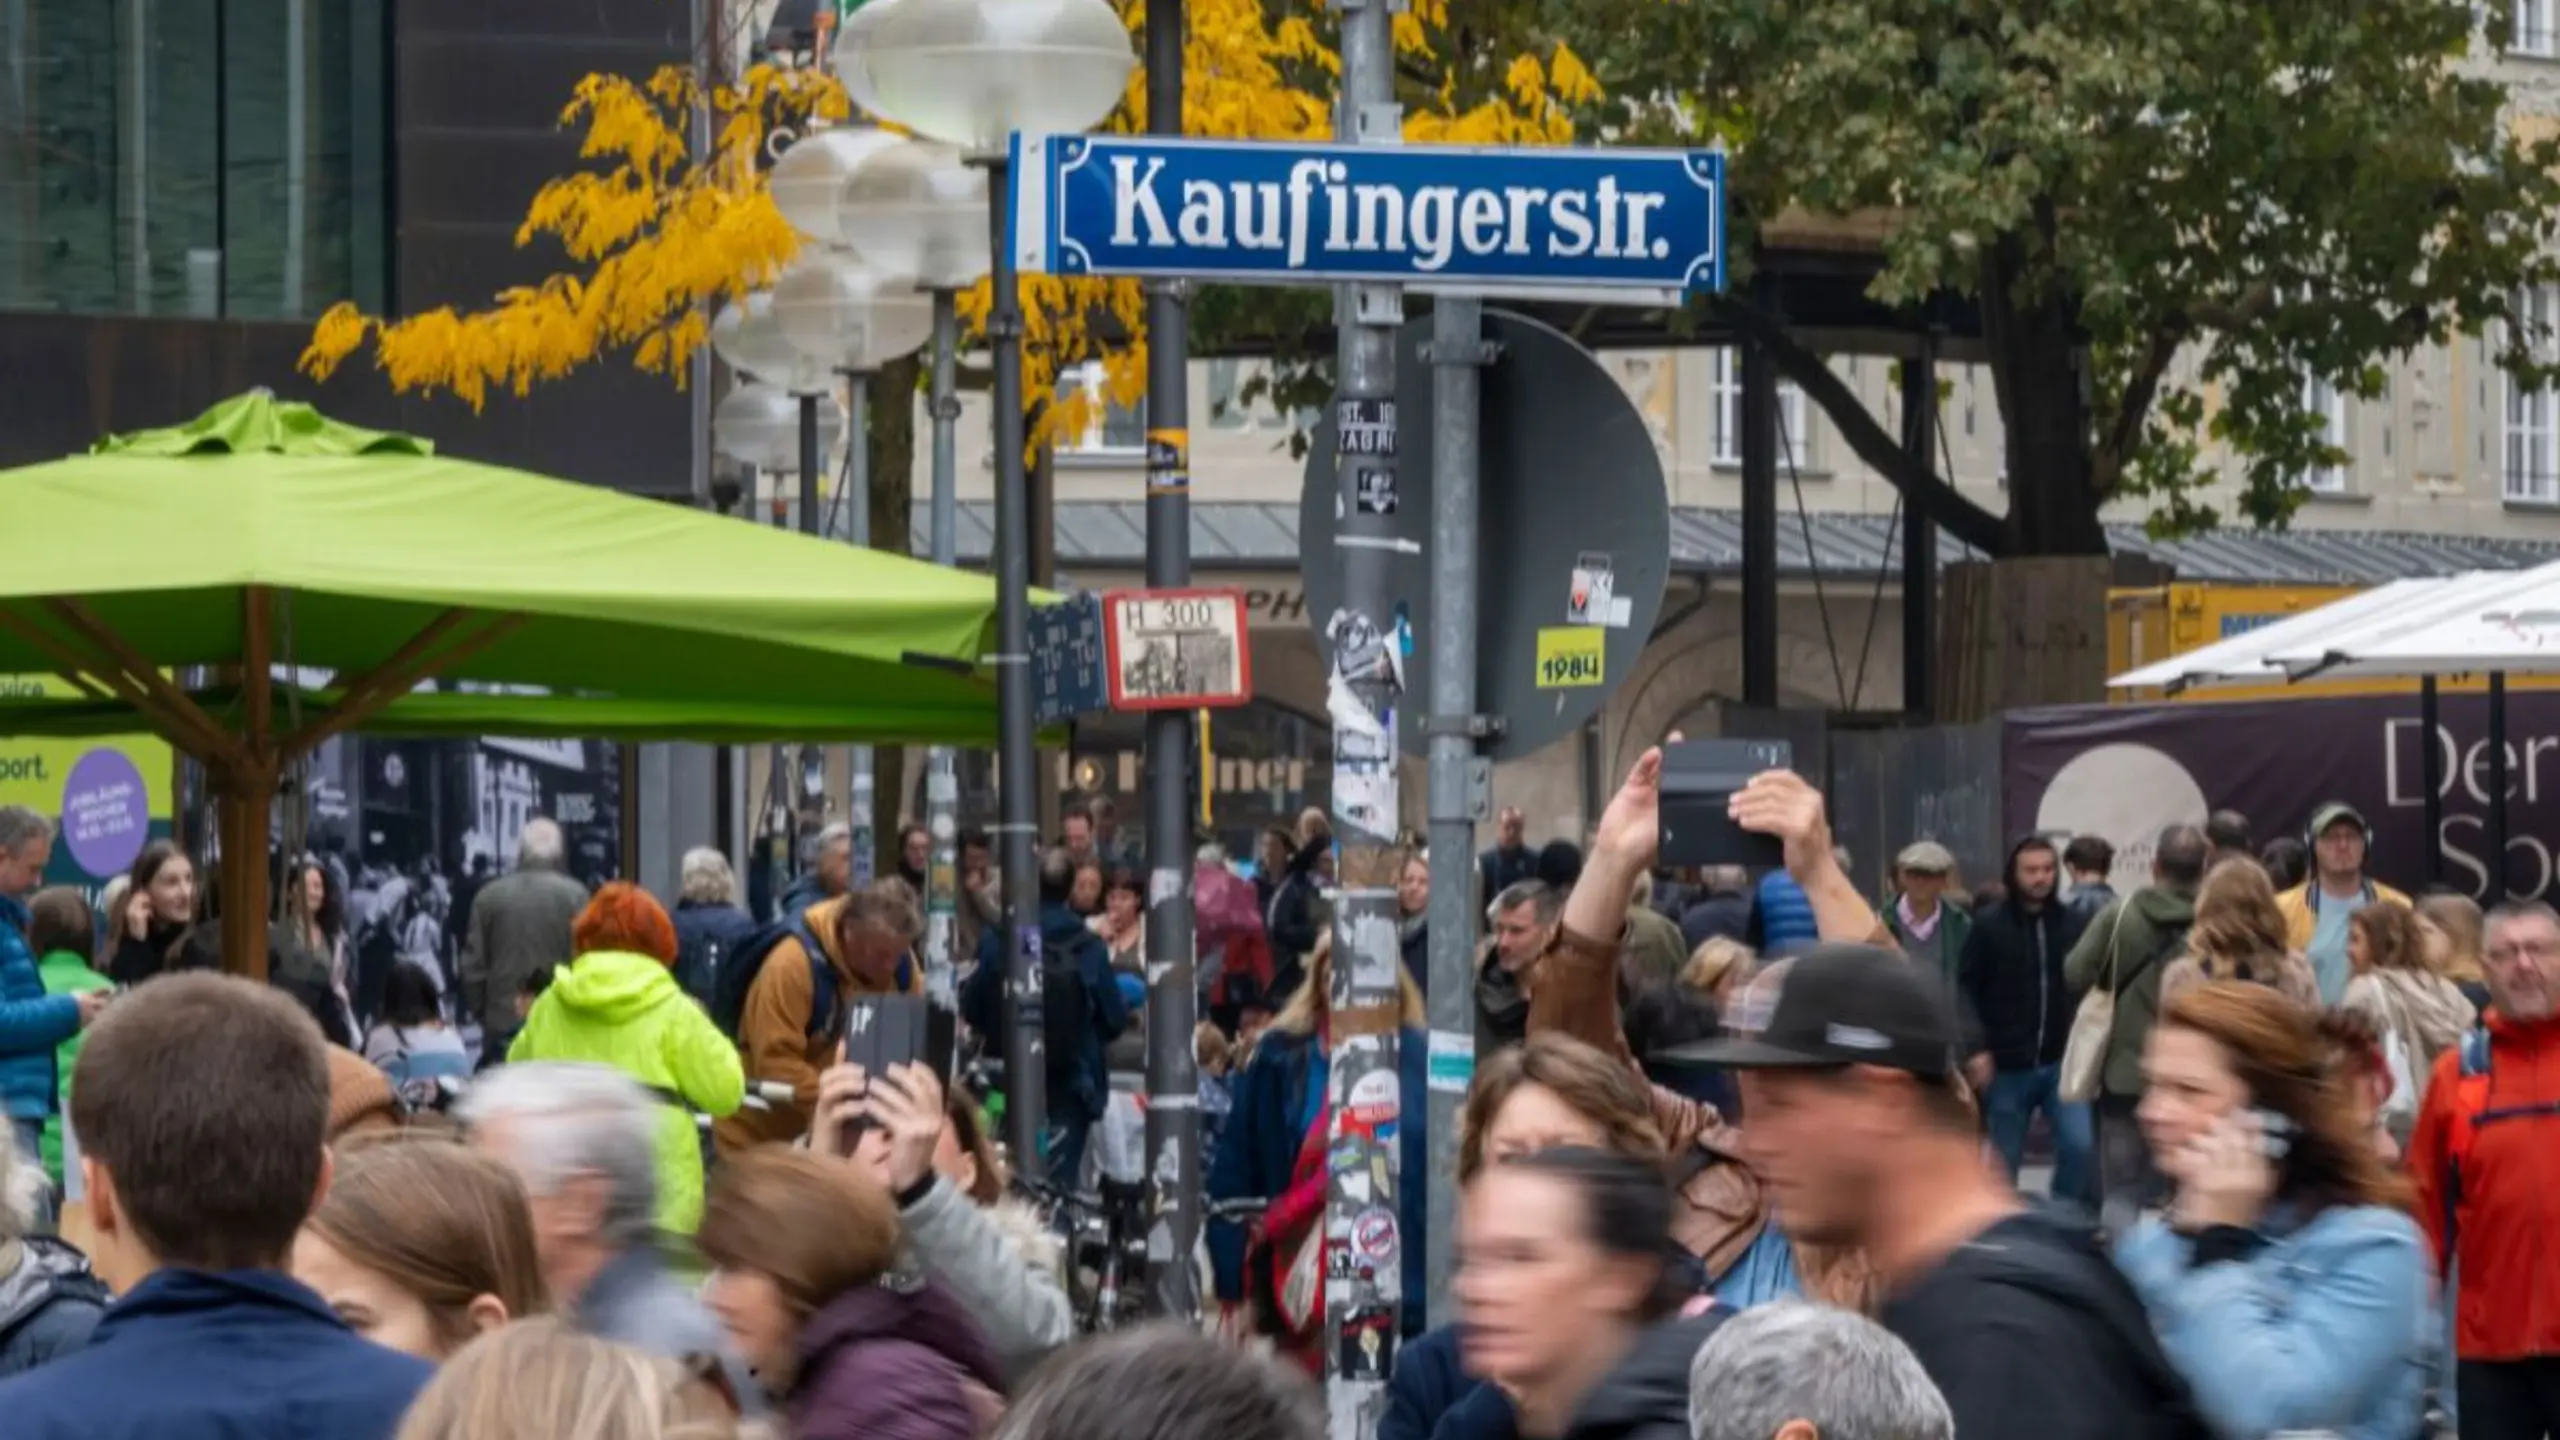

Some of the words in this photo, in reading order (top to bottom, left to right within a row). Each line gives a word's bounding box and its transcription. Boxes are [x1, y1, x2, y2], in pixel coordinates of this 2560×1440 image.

[1110, 154, 1671, 271] Kaufingerstr.
[1163, 598, 1211, 628] 300
[1543, 655, 1598, 683] 1984
[2385, 716, 2558, 807] Der
